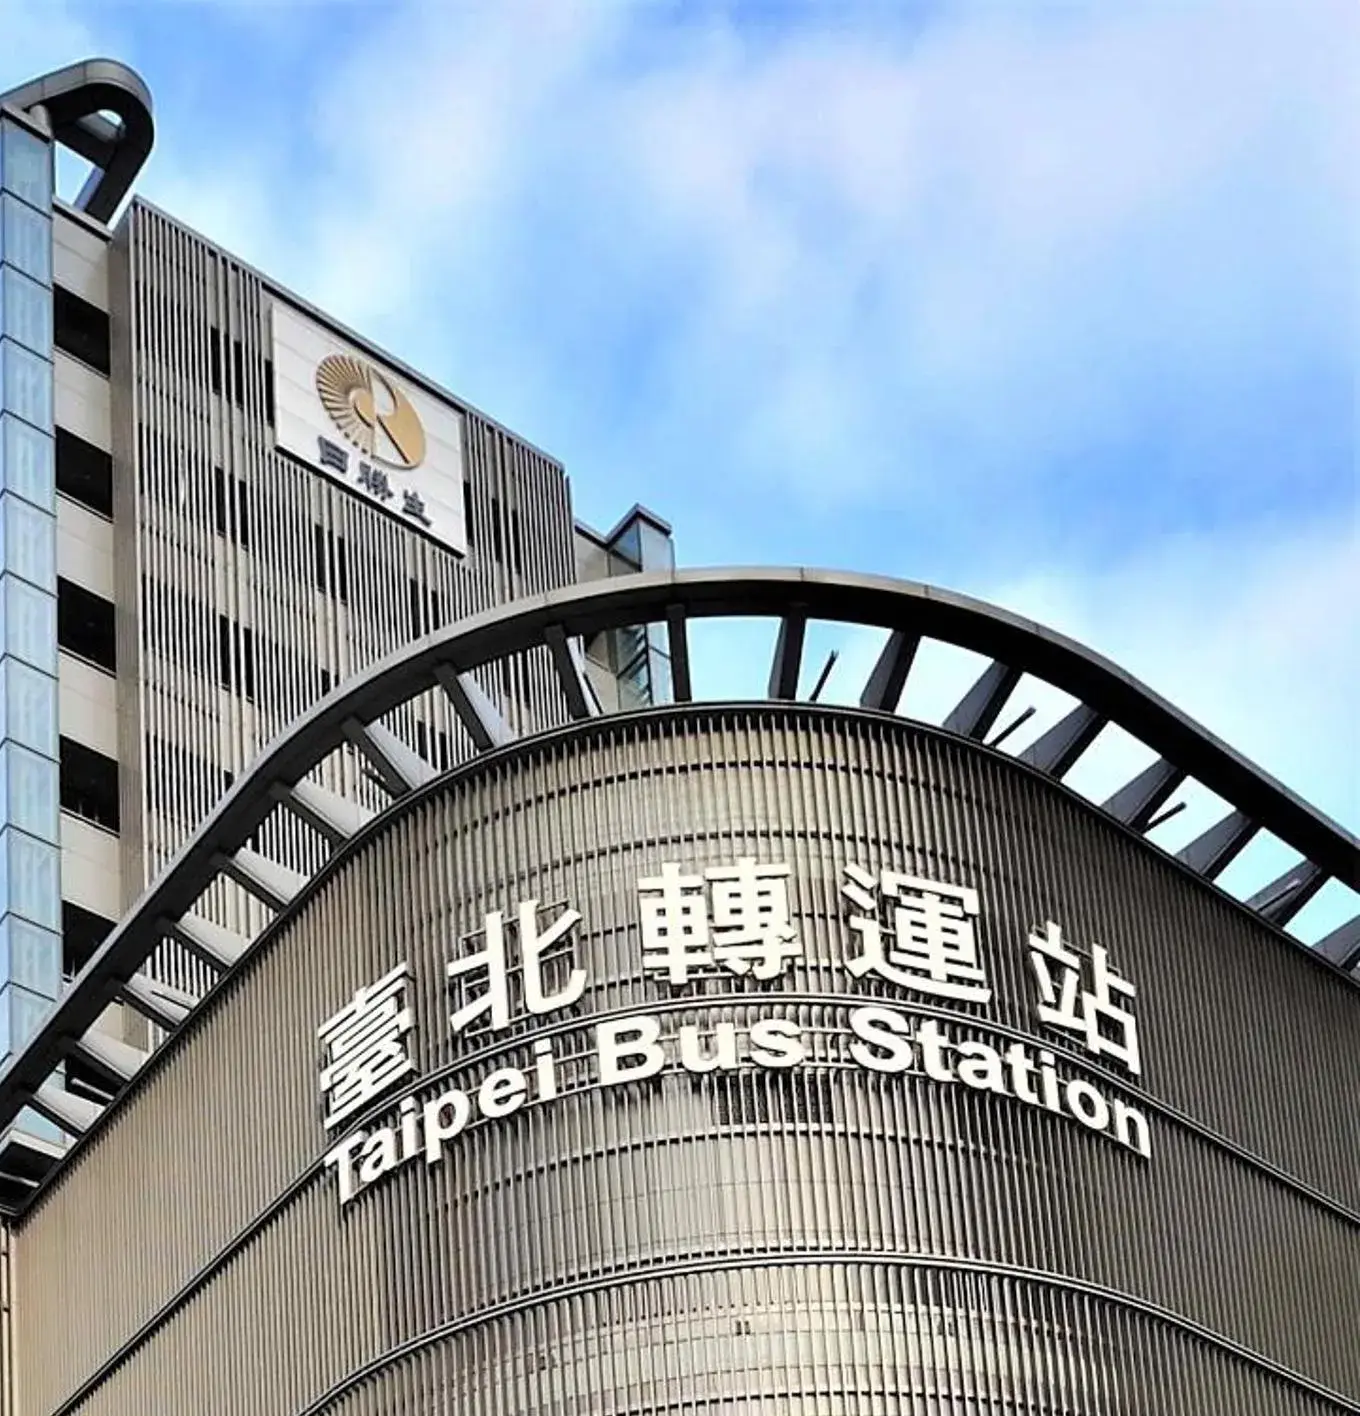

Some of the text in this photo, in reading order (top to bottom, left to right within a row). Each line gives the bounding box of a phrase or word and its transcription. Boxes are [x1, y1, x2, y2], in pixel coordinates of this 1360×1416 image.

[318, 857, 1143, 1130] 臺北轉運站
[324, 1007, 1152, 1206] Taipei Bus Station
